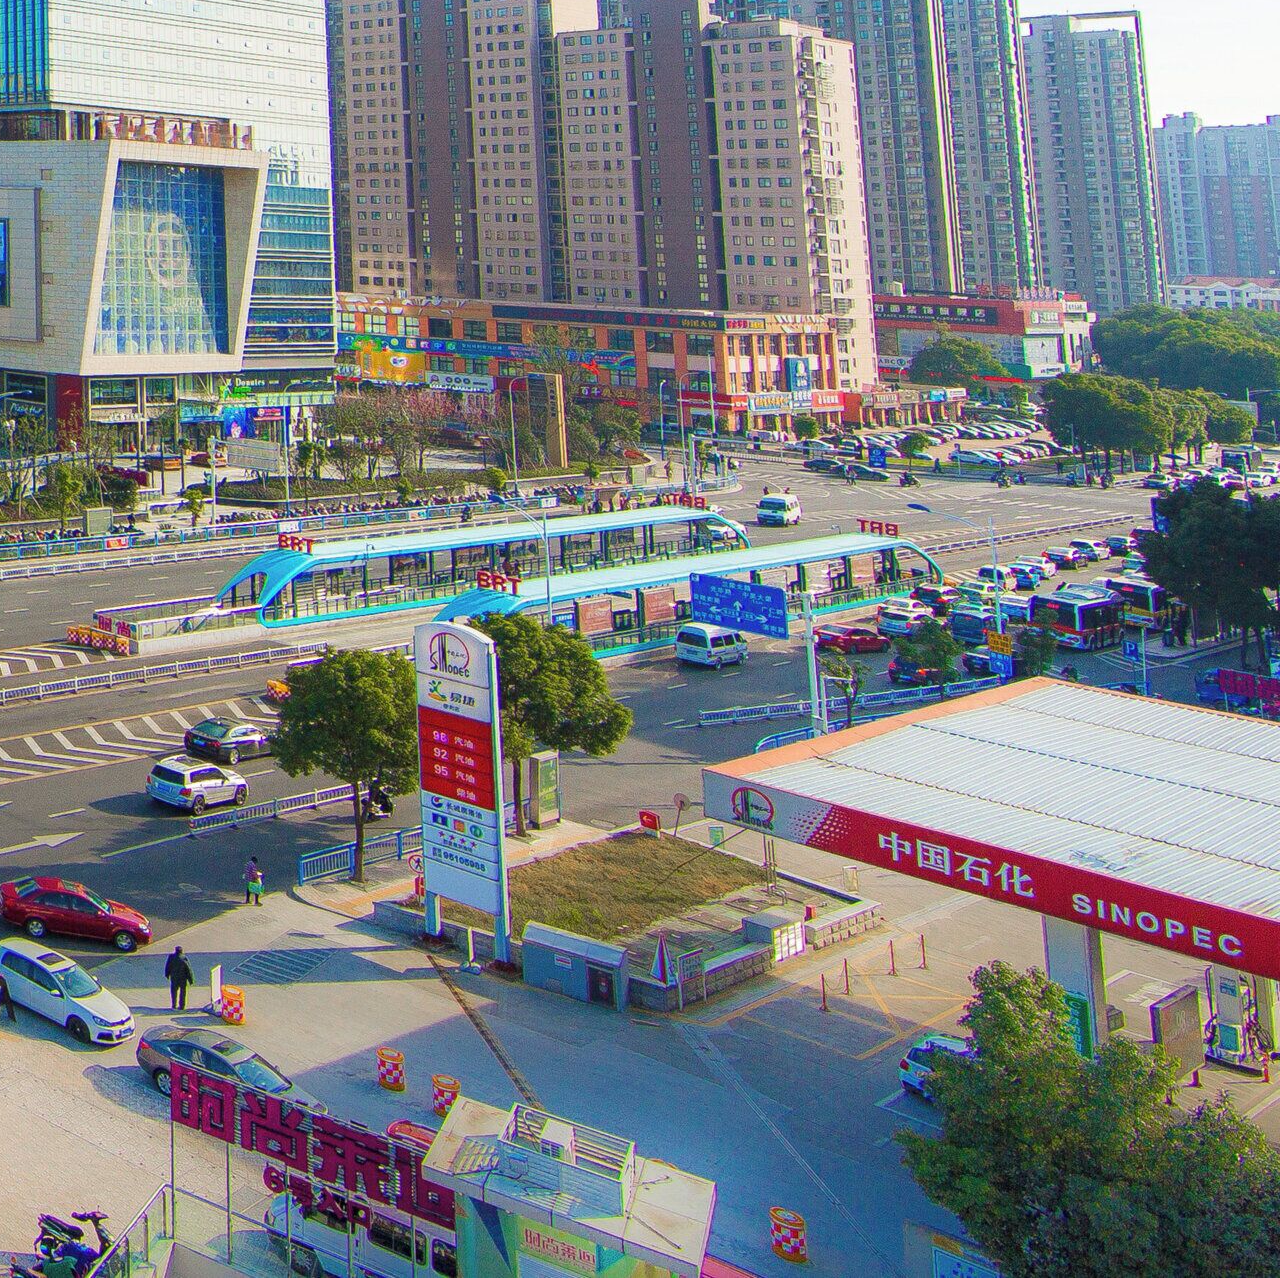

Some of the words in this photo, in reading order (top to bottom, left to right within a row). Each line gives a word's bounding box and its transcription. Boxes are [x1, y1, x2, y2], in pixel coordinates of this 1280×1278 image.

[278, 533, 314, 554] BRT
[477, 570, 522, 595] BRT
[450, 692, 475, 707] 易捷
[454, 736, 474, 750] 汽油
[433, 747, 448, 760] 92
[455, 753, 475, 766] 汽油
[434, 764, 449, 777] 95
[456, 770, 475, 784] 汽油
[878, 831, 1037, 900] 中国石化
[1071, 892, 1245, 958] SINOPEC
